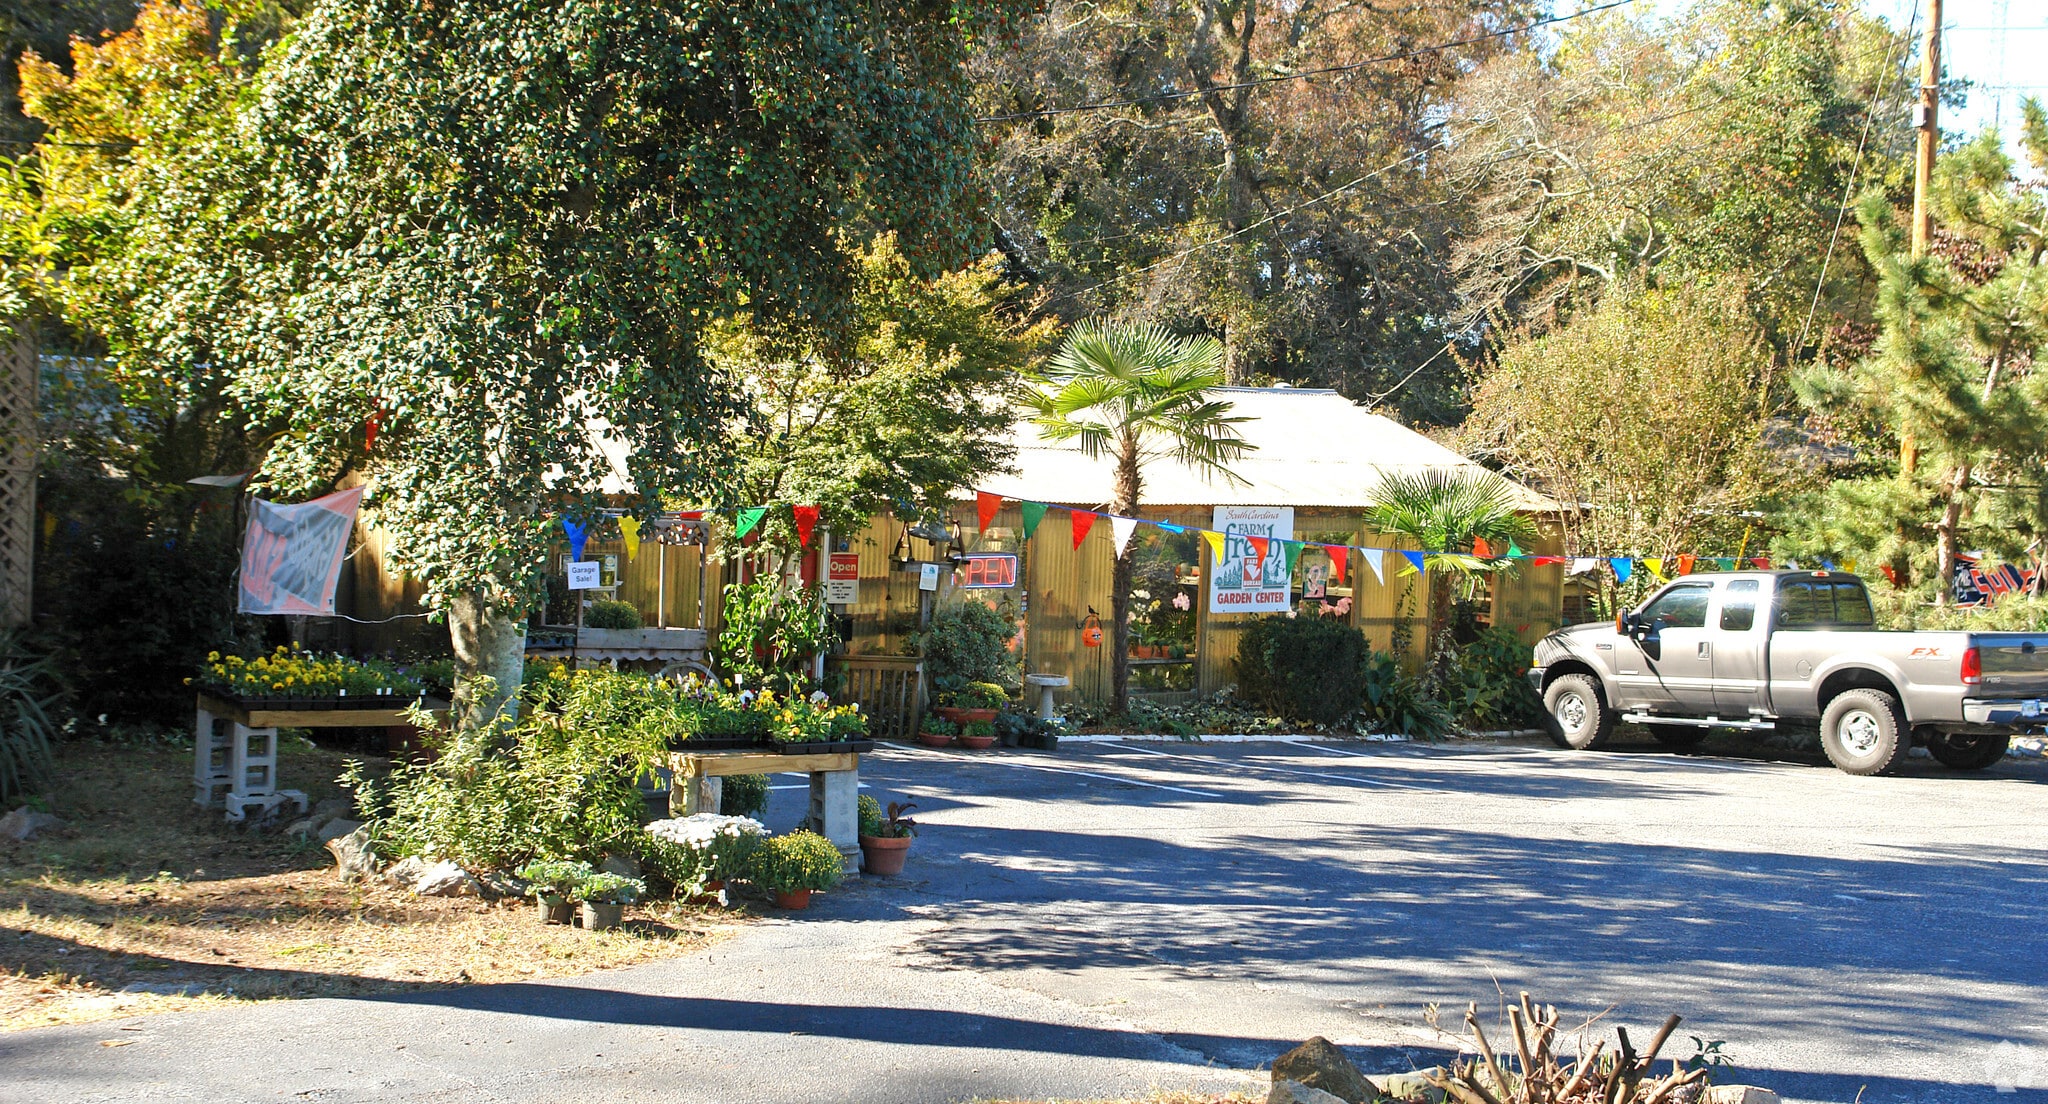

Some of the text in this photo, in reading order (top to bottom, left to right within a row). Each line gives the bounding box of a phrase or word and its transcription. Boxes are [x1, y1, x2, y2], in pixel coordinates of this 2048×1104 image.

[1226, 510, 1280, 520] South Carolina
[1238, 523, 1266, 536] FARM
[1223, 523, 1281, 567] freh
[571, 566, 596, 574] Garage
[830, 561, 857, 573] Open
[575, 575, 593, 583] Sale!
[1217, 592, 1285, 605] GARDEN CENTER
